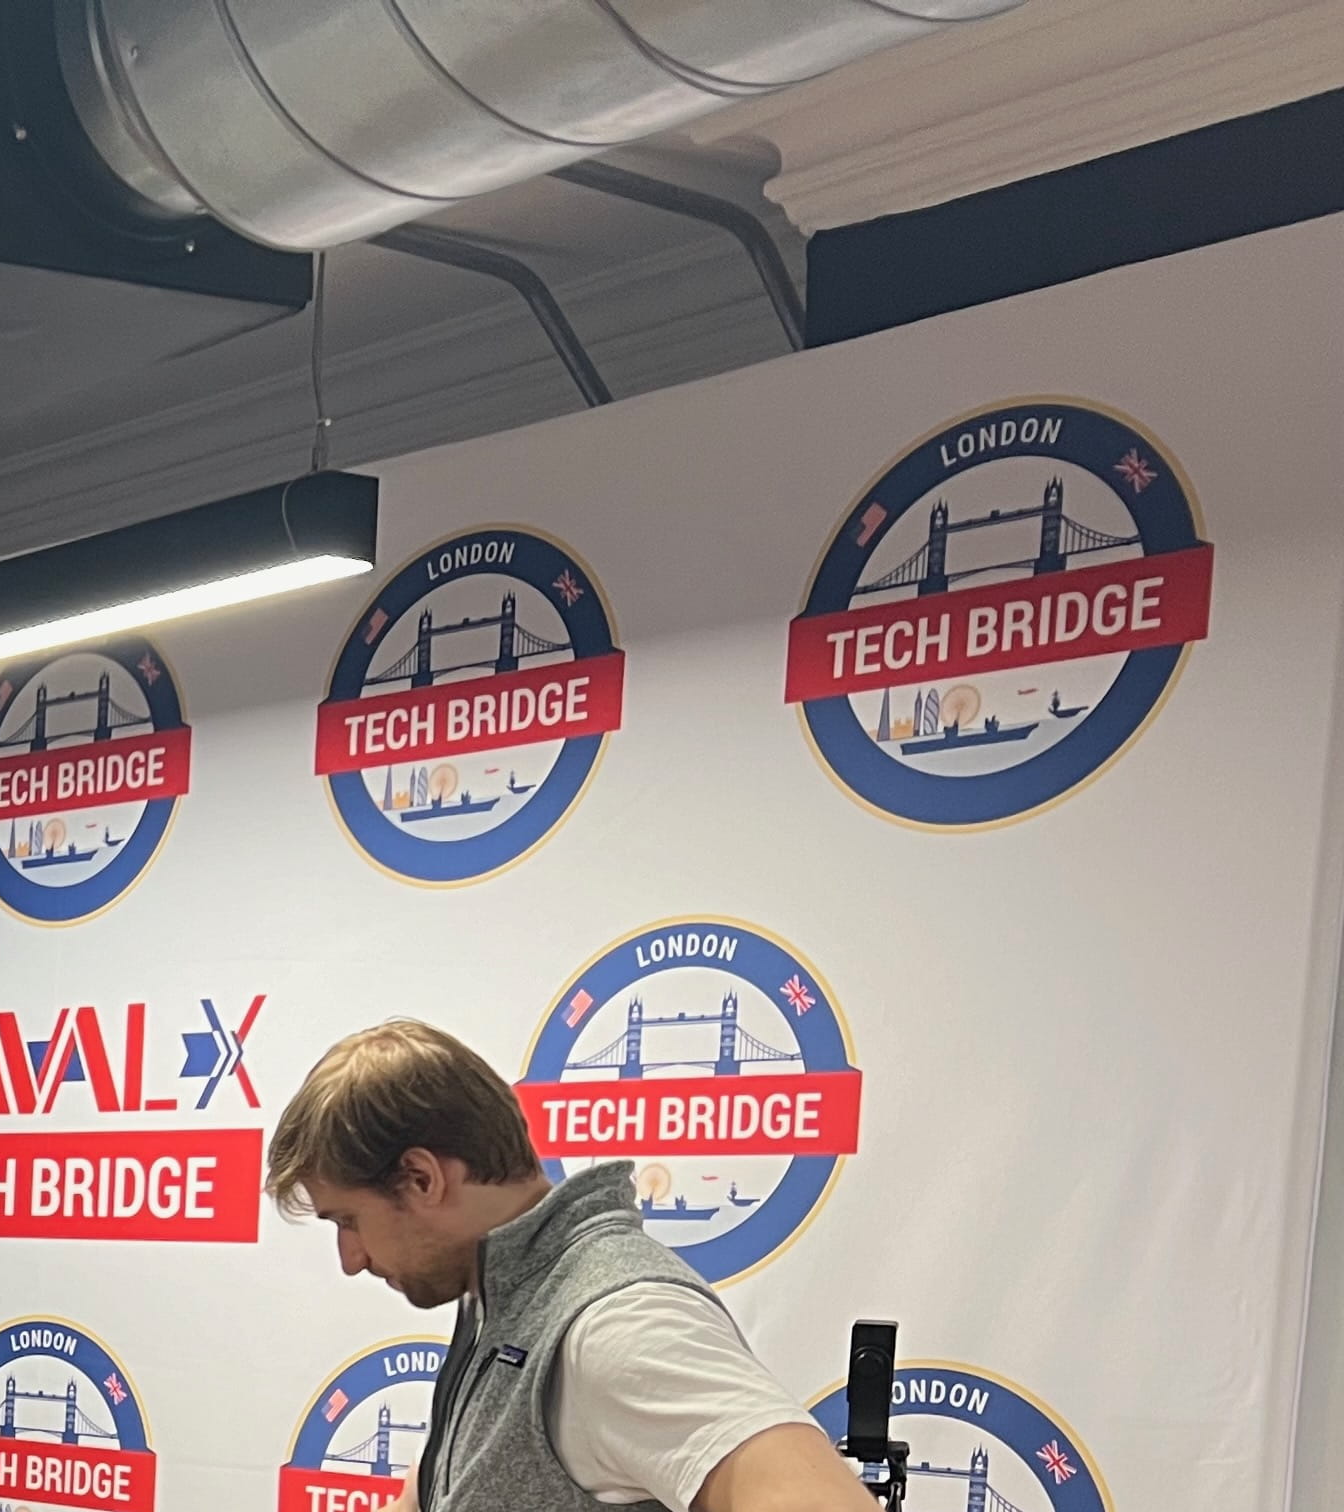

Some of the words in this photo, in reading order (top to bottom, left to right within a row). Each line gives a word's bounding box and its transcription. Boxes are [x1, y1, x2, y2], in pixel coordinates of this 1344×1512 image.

[940, 417, 1063, 467] LONDON
[426, 541, 515, 581] LONDON
[826, 614, 951, 679] TECH
[966, 577, 1164, 658] BRIDGE
[344, 705, 435, 756] TECH
[447, 677, 591, 742] BRIDGE
[57, 747, 165, 800] BRIDGE
[636, 933, 738, 968] LONDON
[542, 1098, 646, 1143] TECH
[658, 1092, 822, 1141] BRIDGE
[30, 1156, 217, 1218] BRIDGE
[10, 1329, 77, 1356] LONDON
[384, 1352, 444, 1377] LOND
[892, 1379, 989, 1415] ONDON
[25, 1455, 131, 1502] BRIDGE
